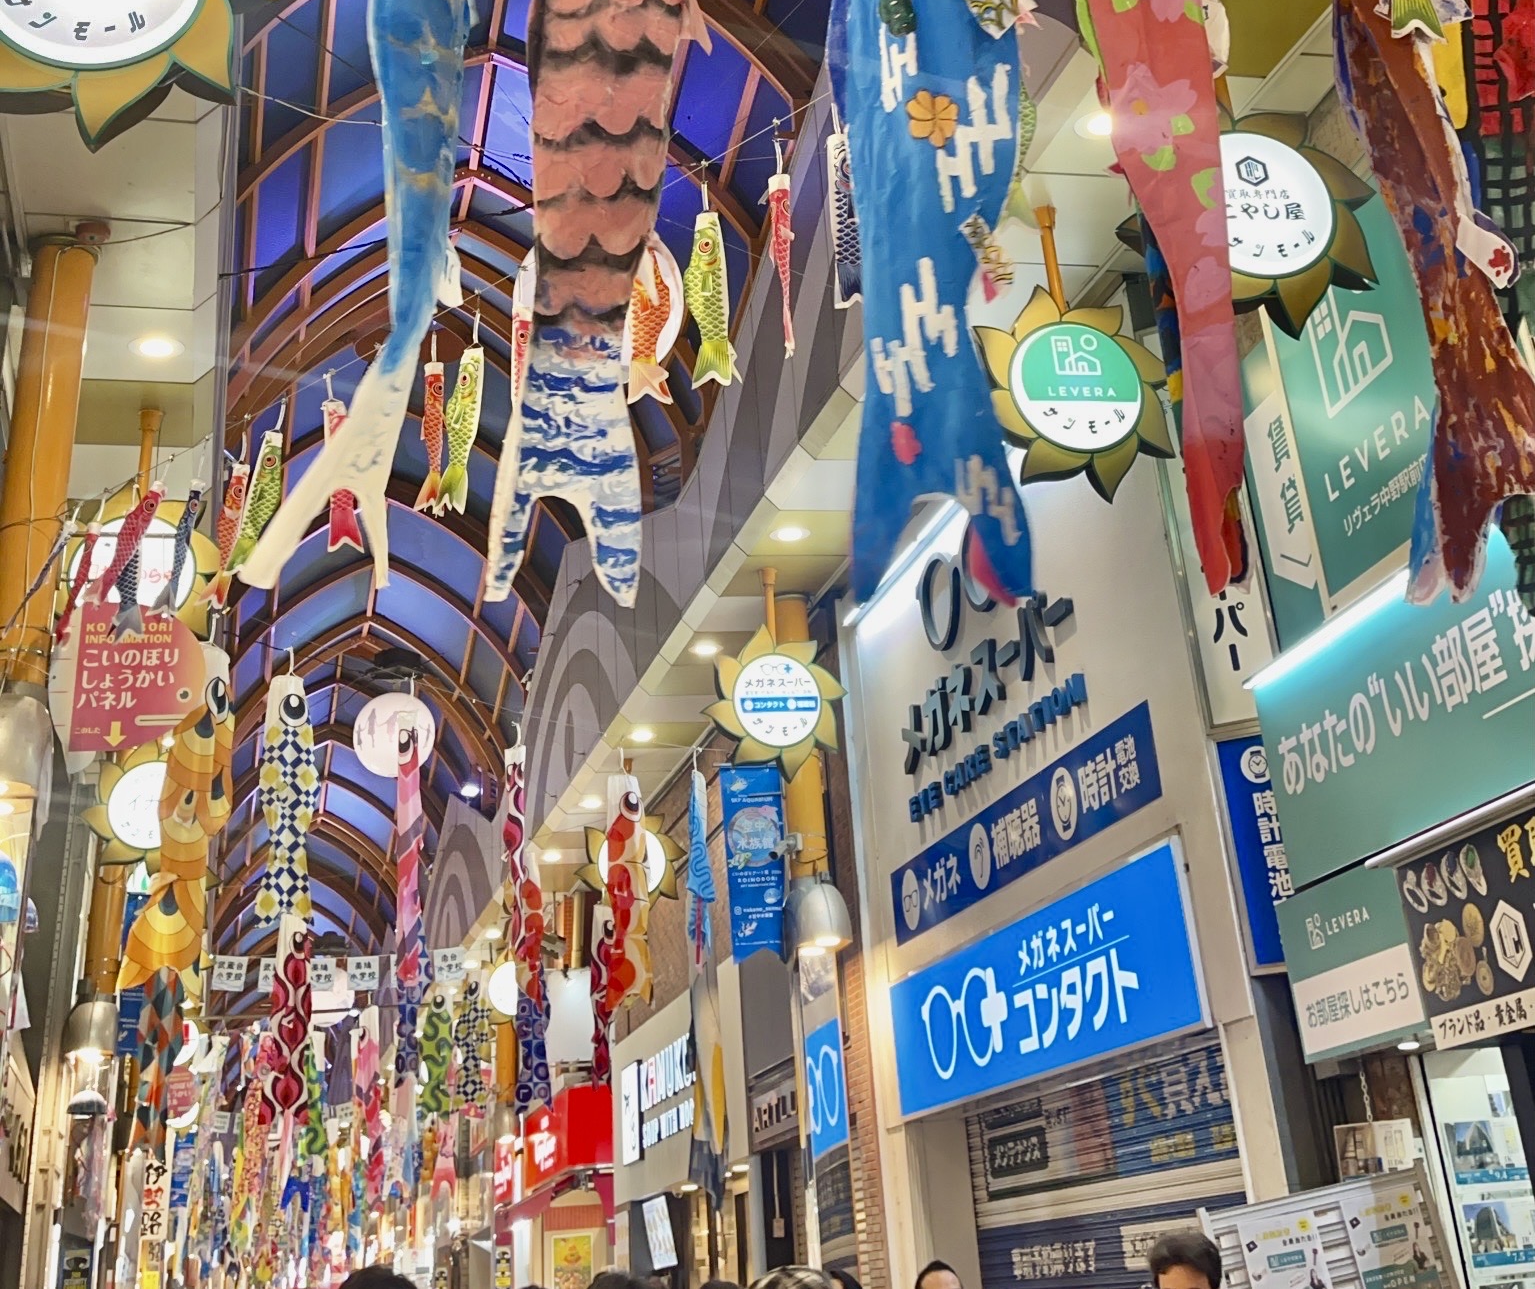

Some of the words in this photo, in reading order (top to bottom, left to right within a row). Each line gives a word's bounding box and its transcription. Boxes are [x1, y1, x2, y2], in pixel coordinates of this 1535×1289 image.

[1047, 386, 1117, 397] LEVERA
[1042, 407, 1126, 434] サンモール
[1324, 395, 1431, 502] LEVERA
[1267, 413, 1304, 535] 賃貸
[85, 634, 172, 644] INFOMATION
[86, 622, 173, 632] KOORI
[1213, 590, 1248, 671] パー
[83, 648, 179, 667] こいのぼり
[81, 669, 175, 689] しょうかい
[745, 678, 811, 688] メガネスーパー
[902, 591, 1074, 775] メガネスーパー
[76, 691, 137, 710] パネル
[754, 700, 785, 709] コンタクト
[909, 781, 944, 823] EYE
[943, 745, 993, 796] CARE
[993, 673, 1088, 759] STATION
[1114, 734, 1137, 763] 電池
[1118, 764, 1141, 794] 交換
[737, 837, 774, 850] 水族館
[922, 853, 962, 910] メガネ
[991, 798, 1042, 870] 補聴器
[1077, 748, 1119, 814] 時計
[1252, 790, 1295, 906] 時計電池
[1325, 907, 1370, 936] LEVERA
[1018, 902, 1115, 976] メガネスーパー
[310, 973, 332, 983] 学校
[1013, 948, 1139, 1055] コンタクト
[1305, 973, 1410, 1028] お部屋探しはこちら
